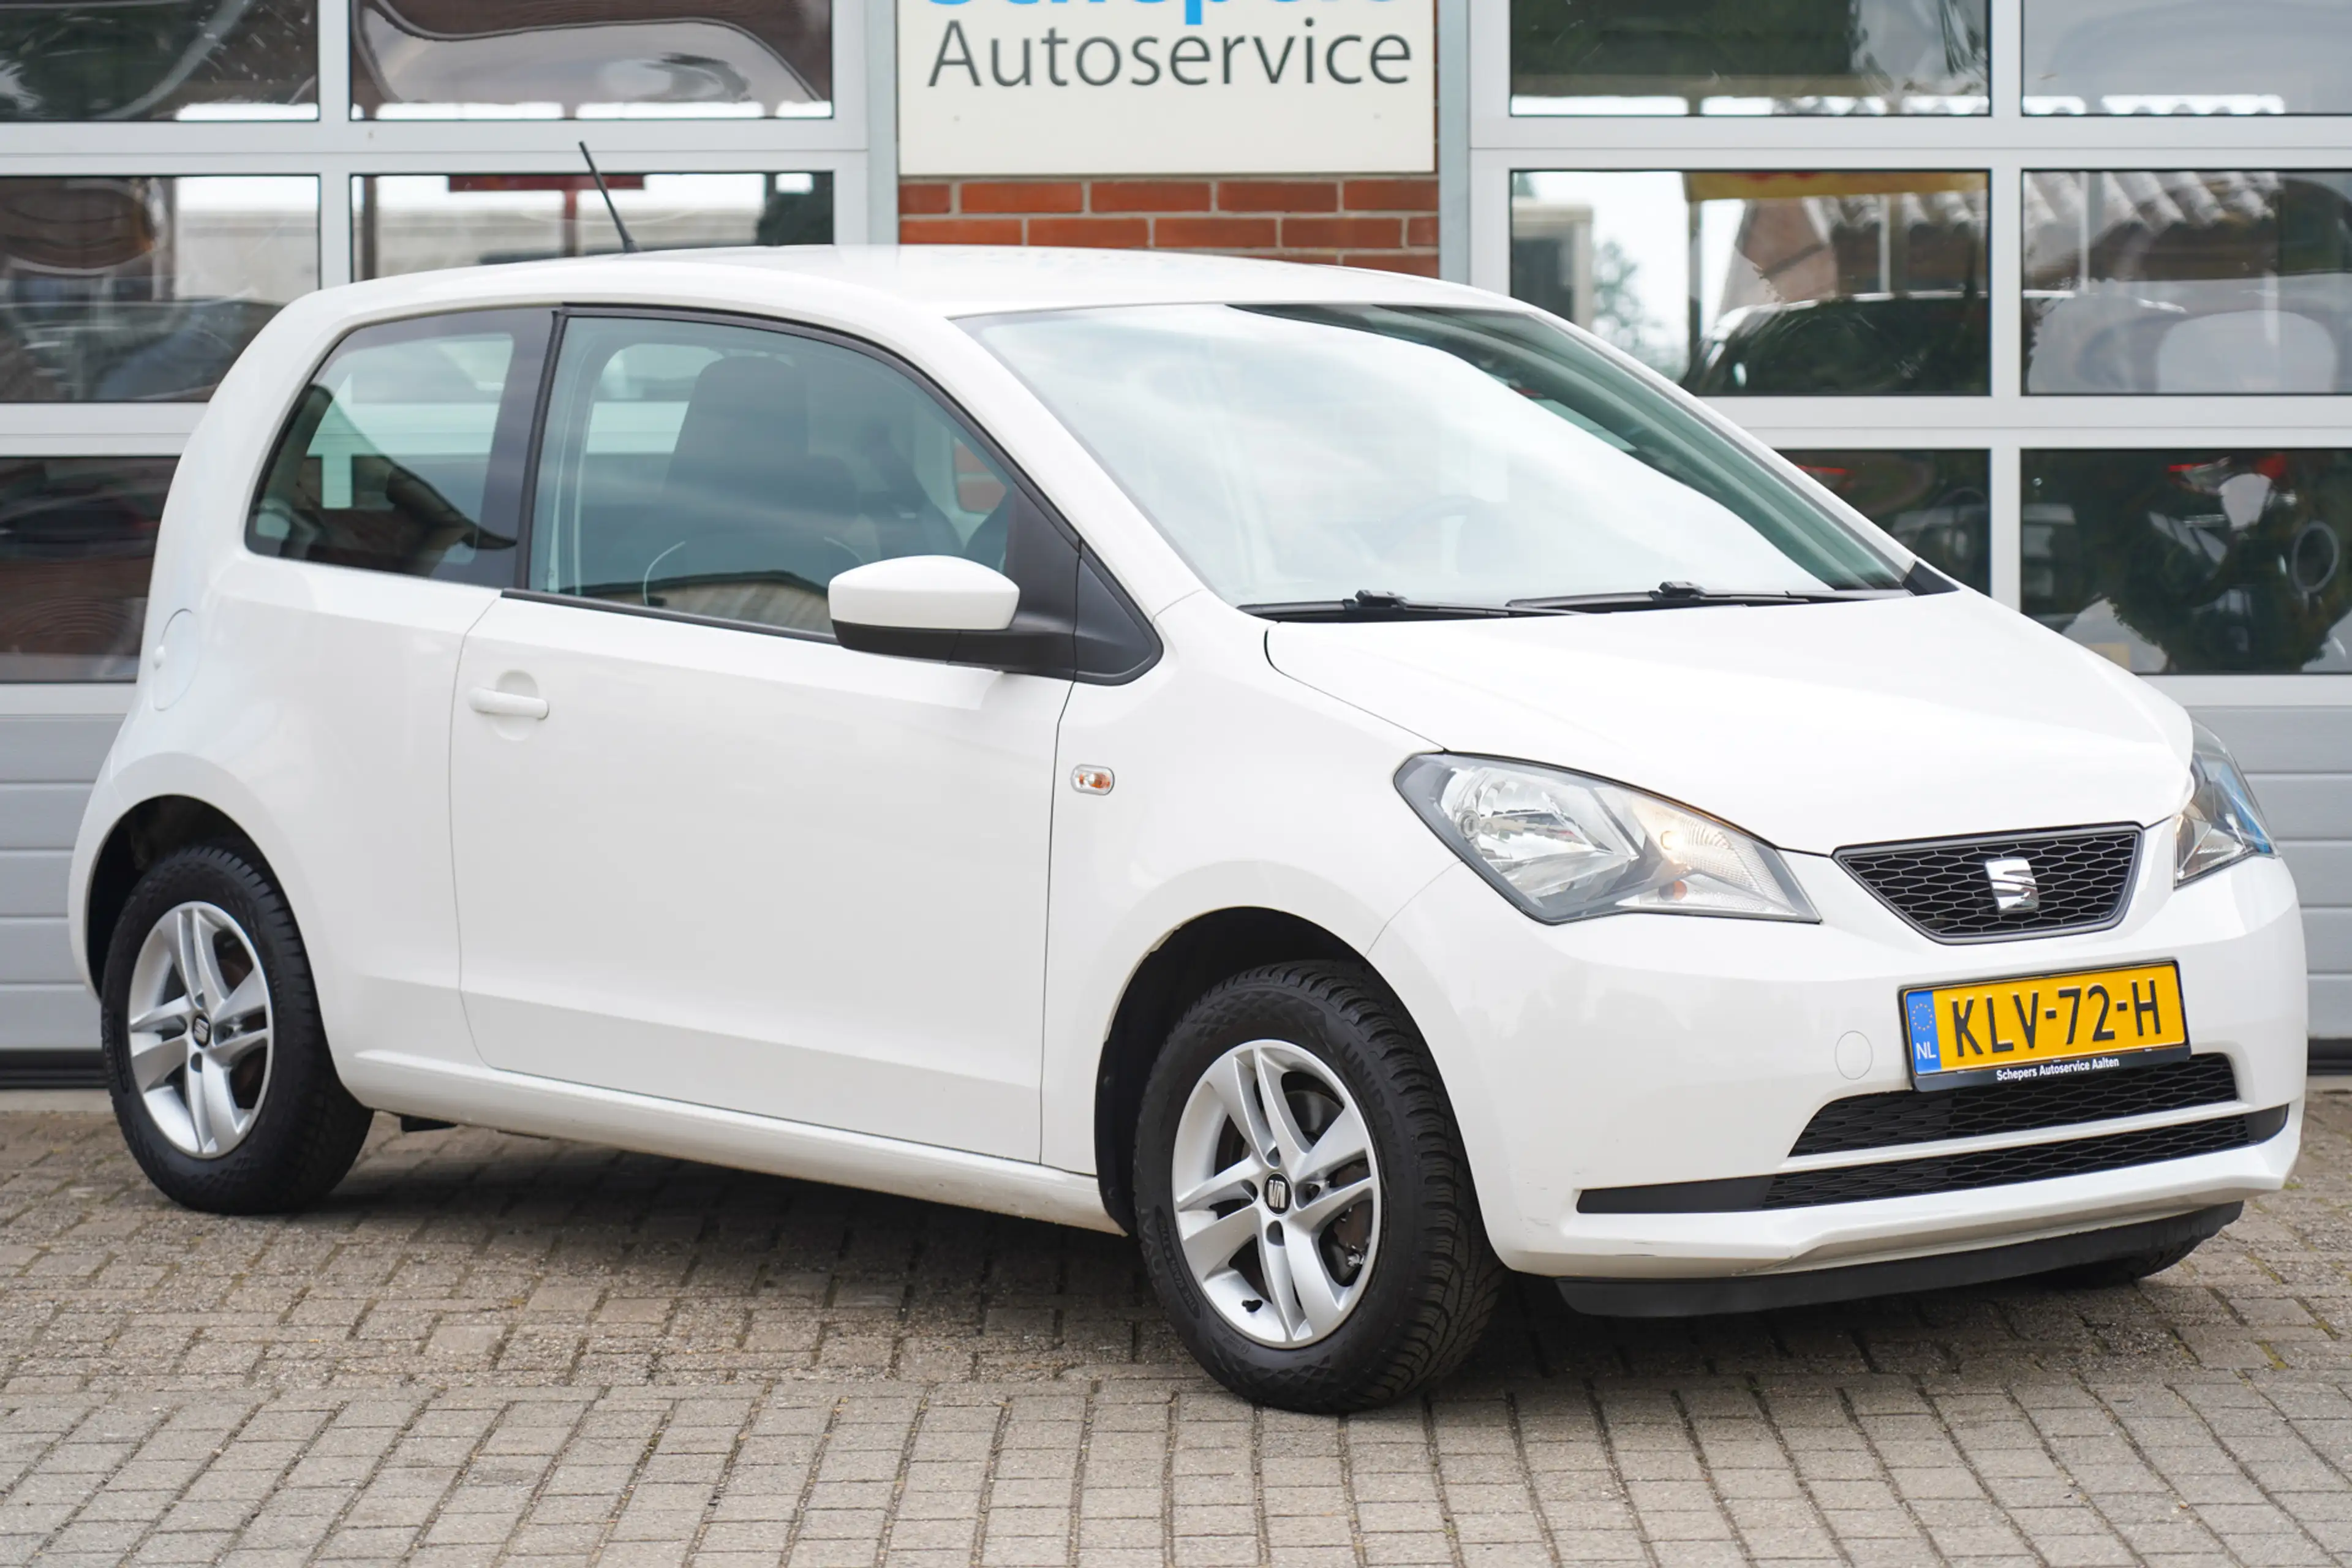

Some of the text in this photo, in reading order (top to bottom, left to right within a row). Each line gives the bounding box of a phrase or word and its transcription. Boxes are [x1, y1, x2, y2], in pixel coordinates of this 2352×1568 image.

[927, 17, 1412, 87] Autoservice
[1951, 978, 2162, 1058] KLV-72-H
[1916, 1041, 1937, 1060] NL
[1996, 1058, 2119, 1081] Schepers Autoservice Aalten
